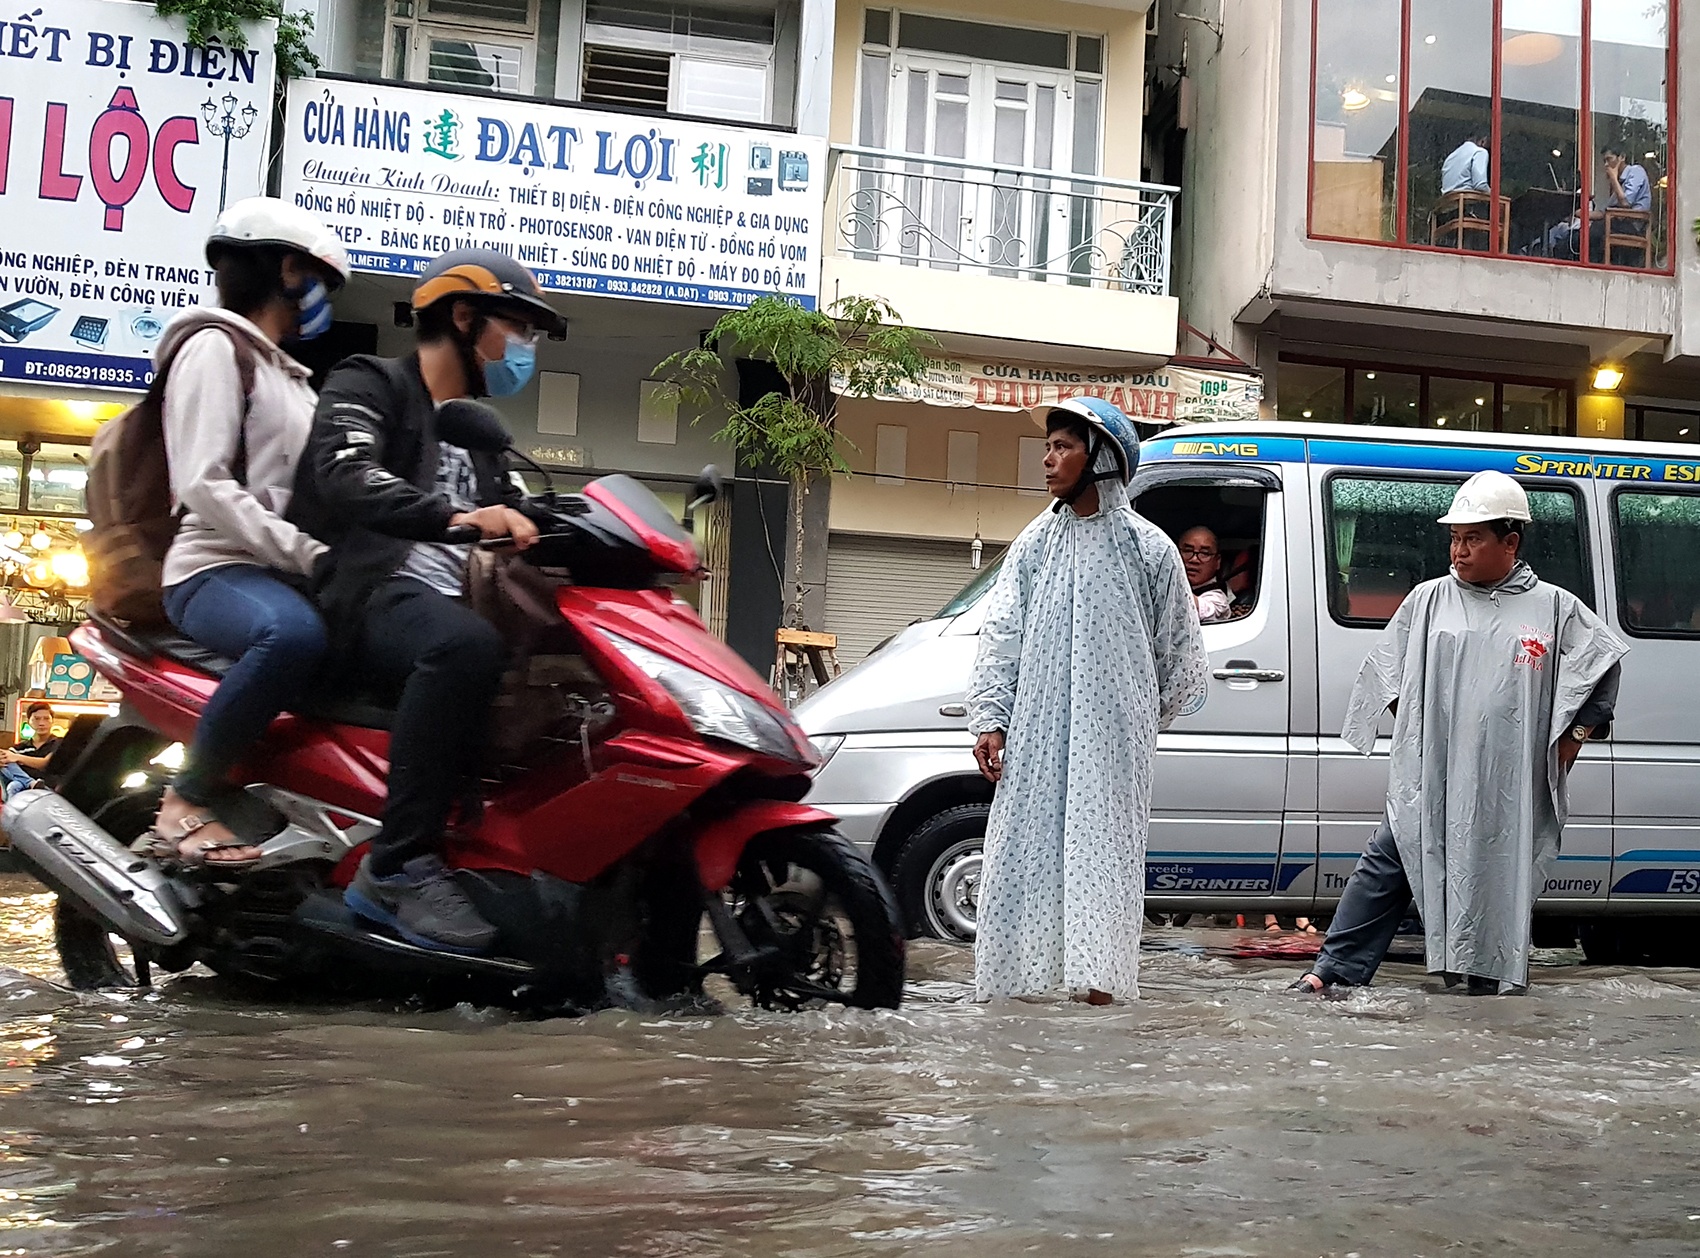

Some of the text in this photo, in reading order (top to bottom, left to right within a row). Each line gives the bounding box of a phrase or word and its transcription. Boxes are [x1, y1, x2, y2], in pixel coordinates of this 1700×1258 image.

[85, 32, 133, 78] BỊ
[147, 35, 259, 88] ĐIỆN
[304, 88, 726, 189] CỬA HÀNG 達 ĐẠT LỢI 利
[39, 86, 199, 232] LỘC
[303, 159, 370, 185] Chuyên
[376, 167, 425, 190] Kinh
[431, 173, 500, 198] Doanh:
[509, 183, 547, 206] THIẾT
[552, 191, 565, 212] BỊ
[570, 191, 601, 214] ĐIỆN
[614, 195, 644, 219] ĐIỆN
[649, 199, 682, 221] CÔNG
[687, 205, 733, 228] NGHIỆP
[750, 213, 770, 230] GIA
[775, 215, 808, 235] DỤNG
[295, 186, 332, 212] ĐỒNG
[337, 191, 355, 215] HỒ
[361, 197, 401, 222] NHIỆT
[406, 201, 424, 225] ĐỘ
[443, 206, 475, 229] ĐIỆN
[480, 208, 507, 231] TRỞ
[520, 217, 613, 242] PHOTOSENSOR
[626, 228, 651, 246] VAN
[656, 228, 686, 251] ĐIỆN
[720, 232, 754, 256] ĐỒNG
[758, 235, 775, 258] HỒ
[780, 243, 807, 262] VOM
[33, 254, 97, 278] NGHIỆP,
[105, 258, 139, 279] ĐÈN
[145, 265, 199, 285] TRANG
[381, 227, 418, 249] BĂNG
[423, 234, 450, 253] KEO
[518, 242, 558, 266] NHIỆT
[572, 246, 607, 269] SÚNG
[612, 254, 629, 271] ĐO
[634, 254, 673, 278] NHIỆT
[678, 257, 695, 281] ĐỘ
[709, 260, 737, 281] MÁY
[742, 267, 759, 284] ĐO
[764, 266, 781, 288] ĐỘ
[786, 263, 805, 288] ẨM
[15, 275, 63, 300] VƯỜN,
[70, 279, 104, 300] ĐÈN
[111, 283, 155, 305] CÔNG
[161, 288, 199, 307] VIÊN
[25, 361, 133, 383] ĐT:0862918935
[970, 376, 1043, 408] THU
[1198, 443, 1258, 456] AMG
[1146, 864, 1194, 874] rcedes
[1666, 871, 1700, 893] ES
[1542, 879, 1602, 894] journey
